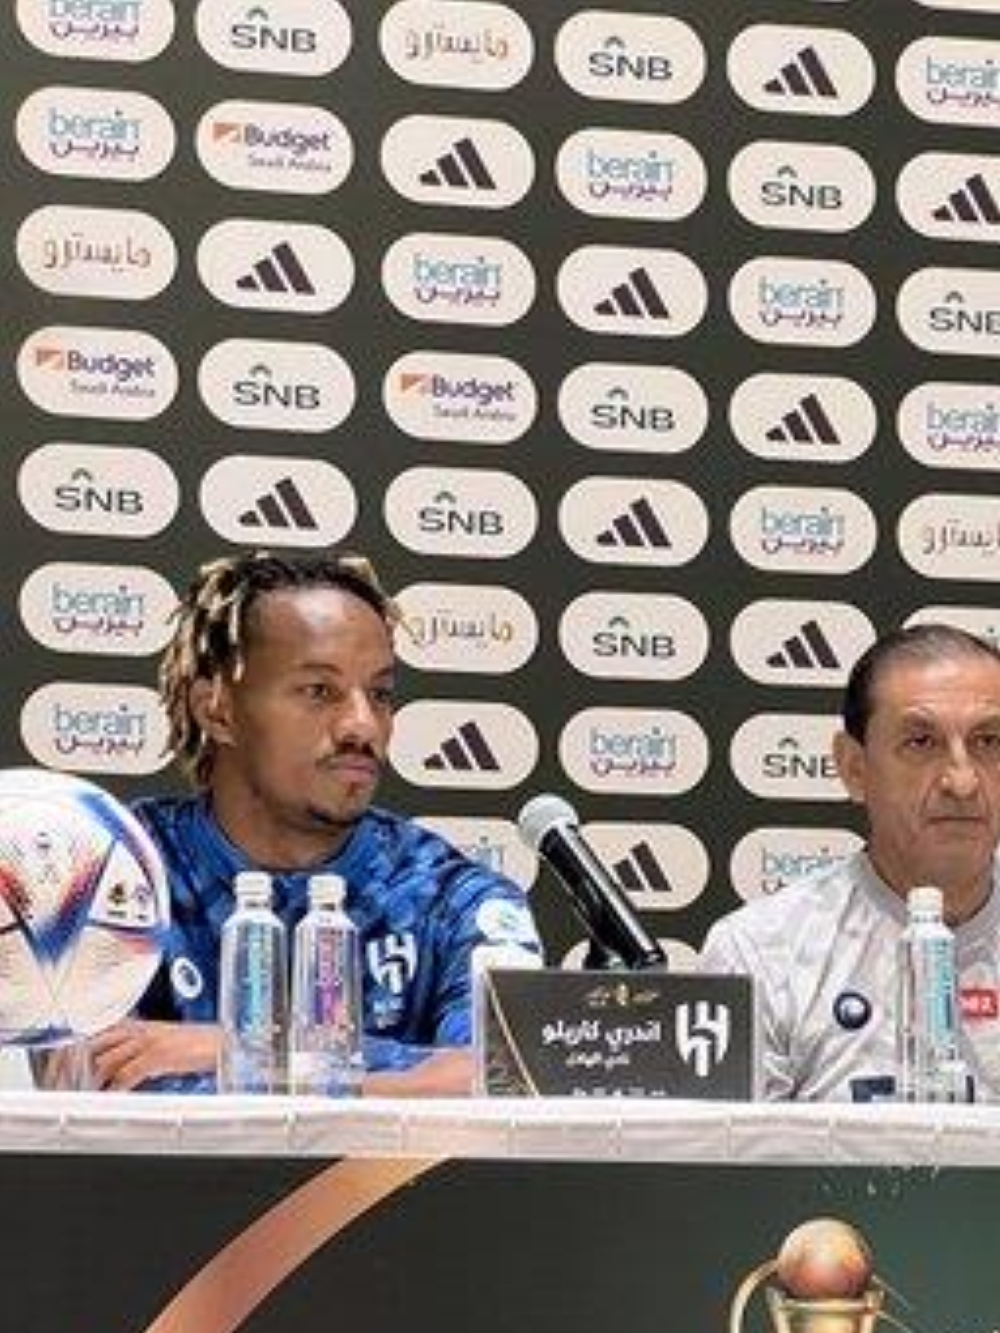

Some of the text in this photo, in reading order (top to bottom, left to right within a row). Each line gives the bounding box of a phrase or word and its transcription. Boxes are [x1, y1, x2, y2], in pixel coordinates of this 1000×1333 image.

[229, 23, 317, 54] SNB
[588, 52, 673, 82] SNB
[49, 108, 141, 139] berain
[245, 123, 334, 157] Budget
[588, 150, 673, 182] berain
[760, 181, 843, 210] SNB
[414, 253, 502, 287] berain
[759, 277, 844, 308] berain
[67, 350, 158, 382] Budget
[232, 380, 320, 410] SNB
[431, 374, 519, 407] Budget
[590, 404, 676, 432] SNB
[55, 485, 144, 515] SNB
[418, 507, 504, 536] SNB
[761, 506, 844, 535] berain
[53, 583, 146, 616] berain
[592, 630, 676, 660] SNB
[54, 704, 146, 736] berain
[591, 727, 676, 758] berain
